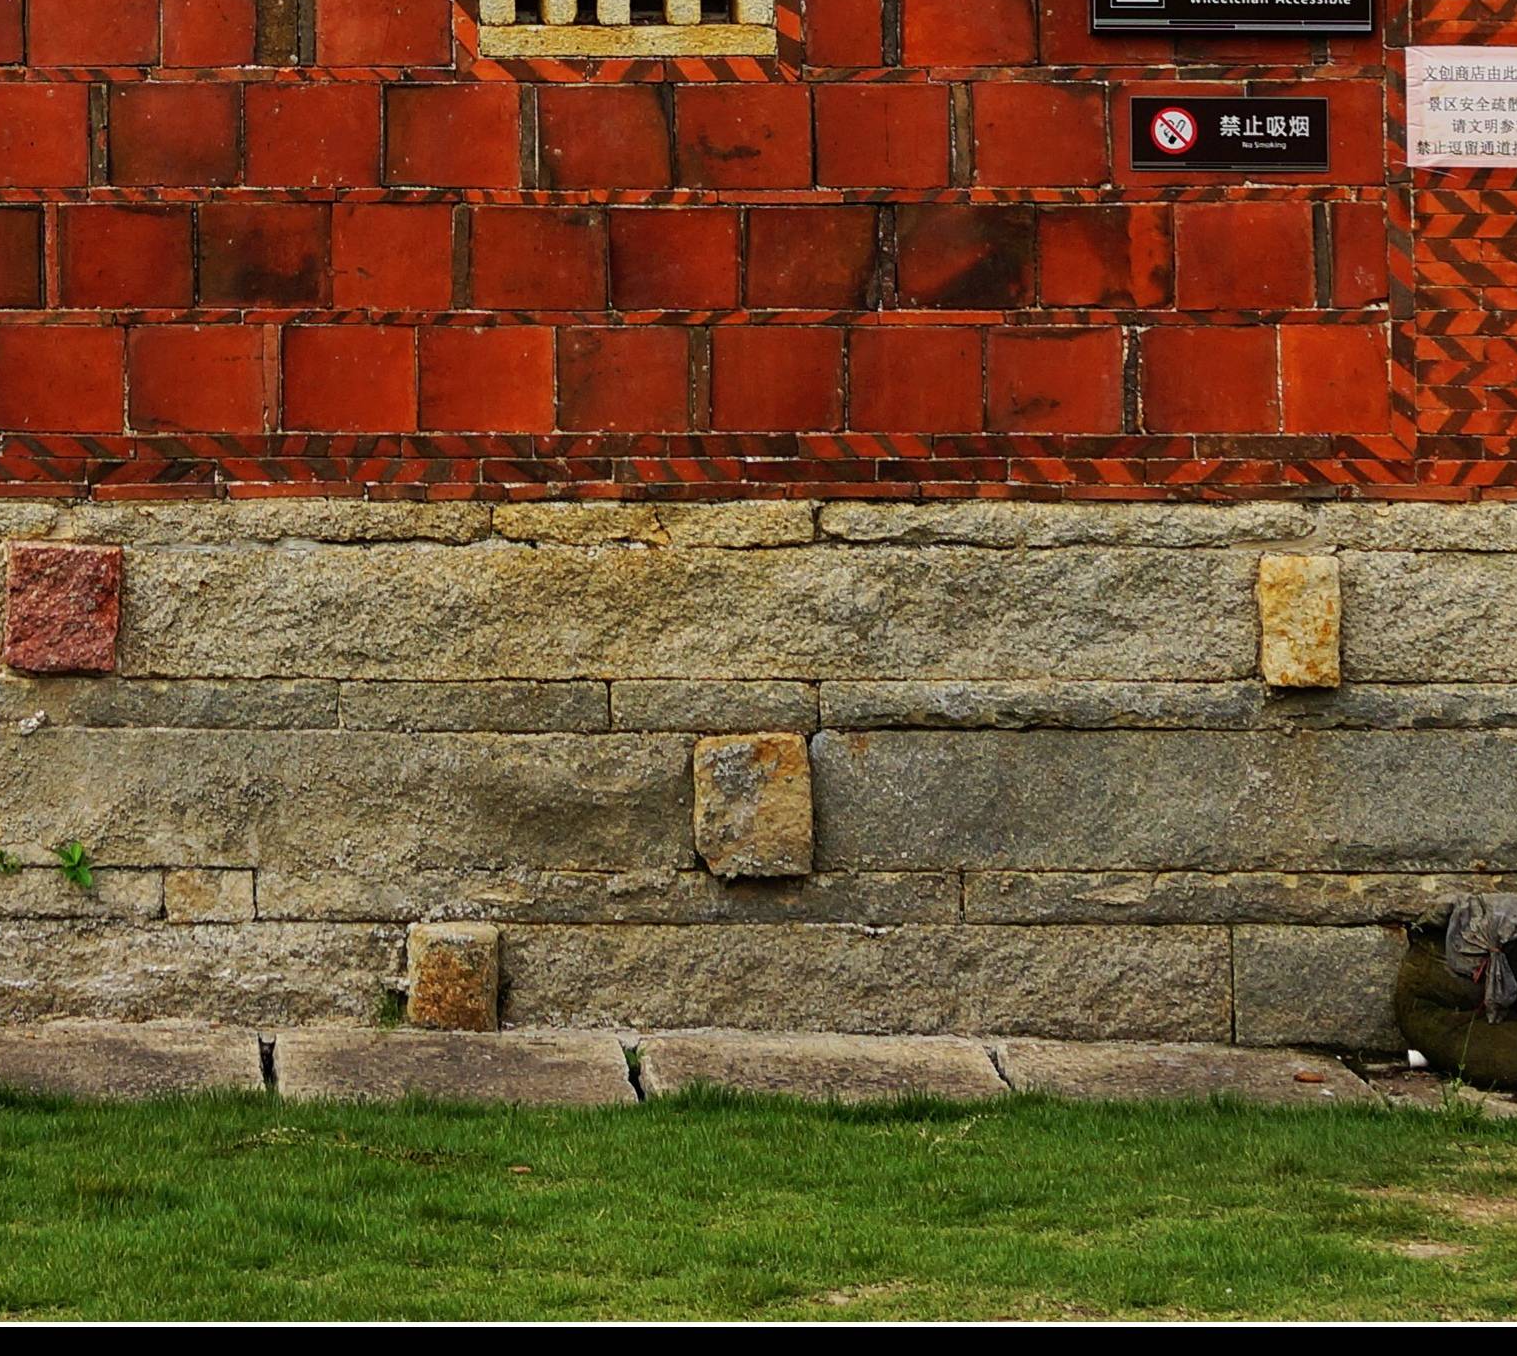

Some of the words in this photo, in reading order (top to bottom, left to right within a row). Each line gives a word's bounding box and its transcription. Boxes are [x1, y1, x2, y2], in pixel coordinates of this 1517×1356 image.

[1219, 115, 1310, 138] 禁止吸烟
[1241, 141, 1253, 149] No
[1254, 141, 1287, 150] Smoking
